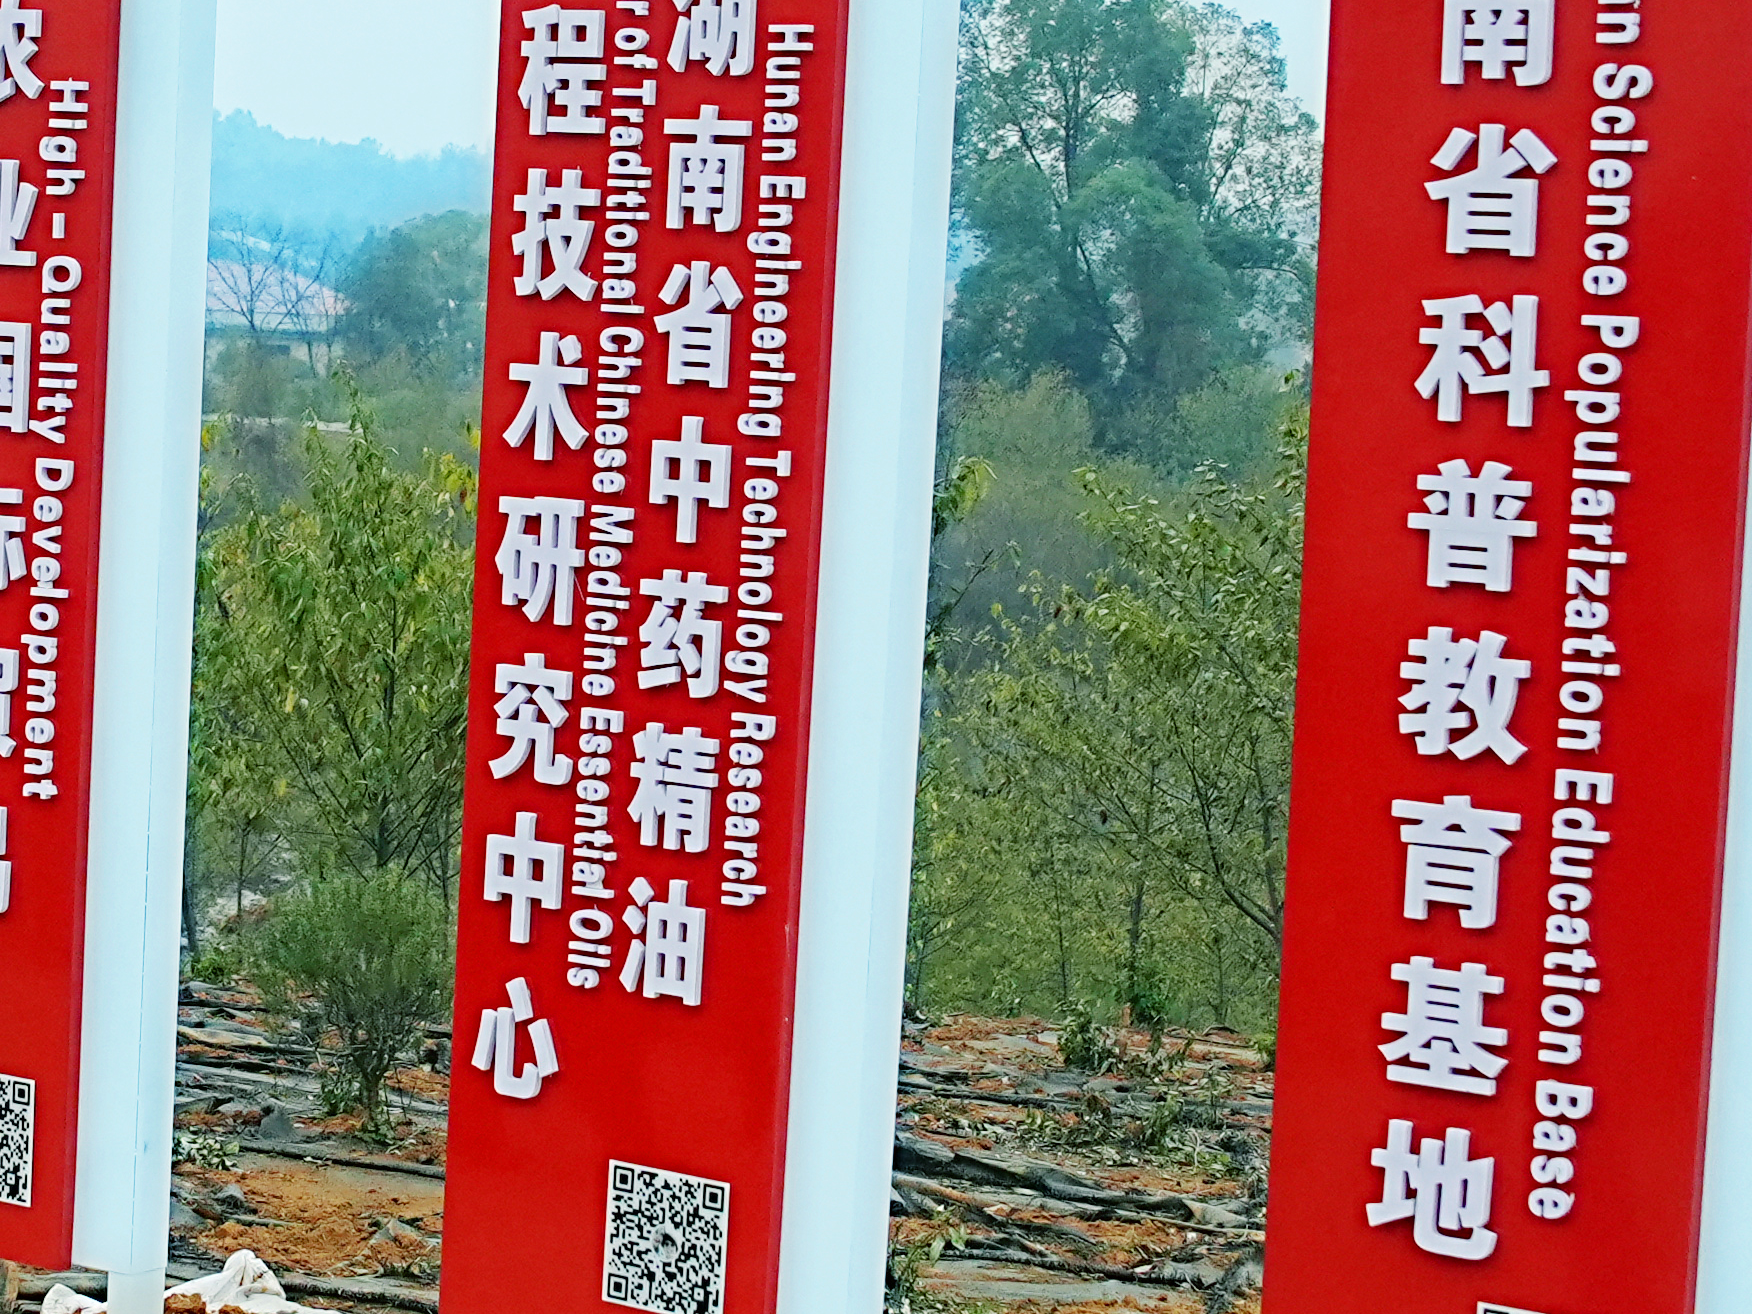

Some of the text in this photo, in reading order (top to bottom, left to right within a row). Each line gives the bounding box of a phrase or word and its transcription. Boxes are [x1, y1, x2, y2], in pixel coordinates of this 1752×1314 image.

[614, 28, 658, 69] of
[601, 80, 656, 313] Traditional
[1583, 63, 1653, 295] Science
[592, 327, 644, 493] Chinese
[721, 24, 814, 906] Hunan Engineering Technology Research
[21, 458, 74, 799] Development
[582, 505, 634, 696] Medicine
[1557, 315, 1639, 753] Popularization
[572, 707, 624, 898] Essential
[567, 905, 613, 988] Oils
[1538, 769, 1613, 1064] Education
[1528, 1079, 1593, 1219] Base
